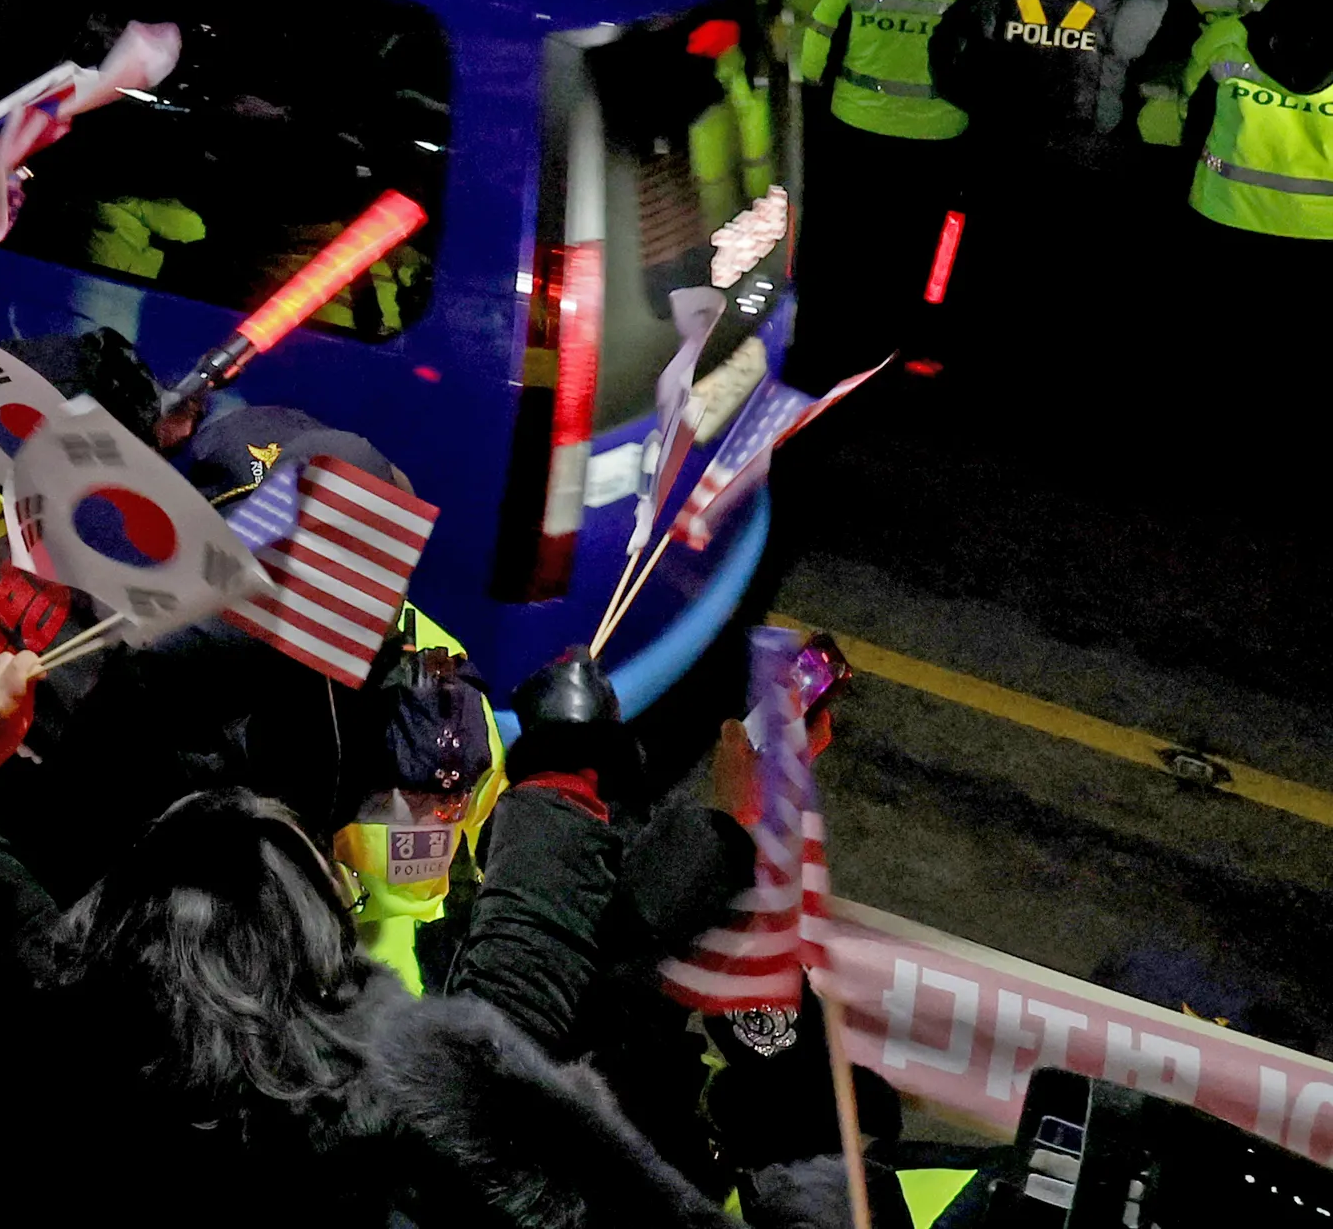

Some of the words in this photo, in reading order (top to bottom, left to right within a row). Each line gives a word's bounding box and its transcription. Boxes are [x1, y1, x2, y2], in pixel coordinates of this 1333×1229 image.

[1005, 21, 1097, 52] POLICE
[396, 832, 447, 859] 경찰
[394, 861, 445, 876] POLICE
